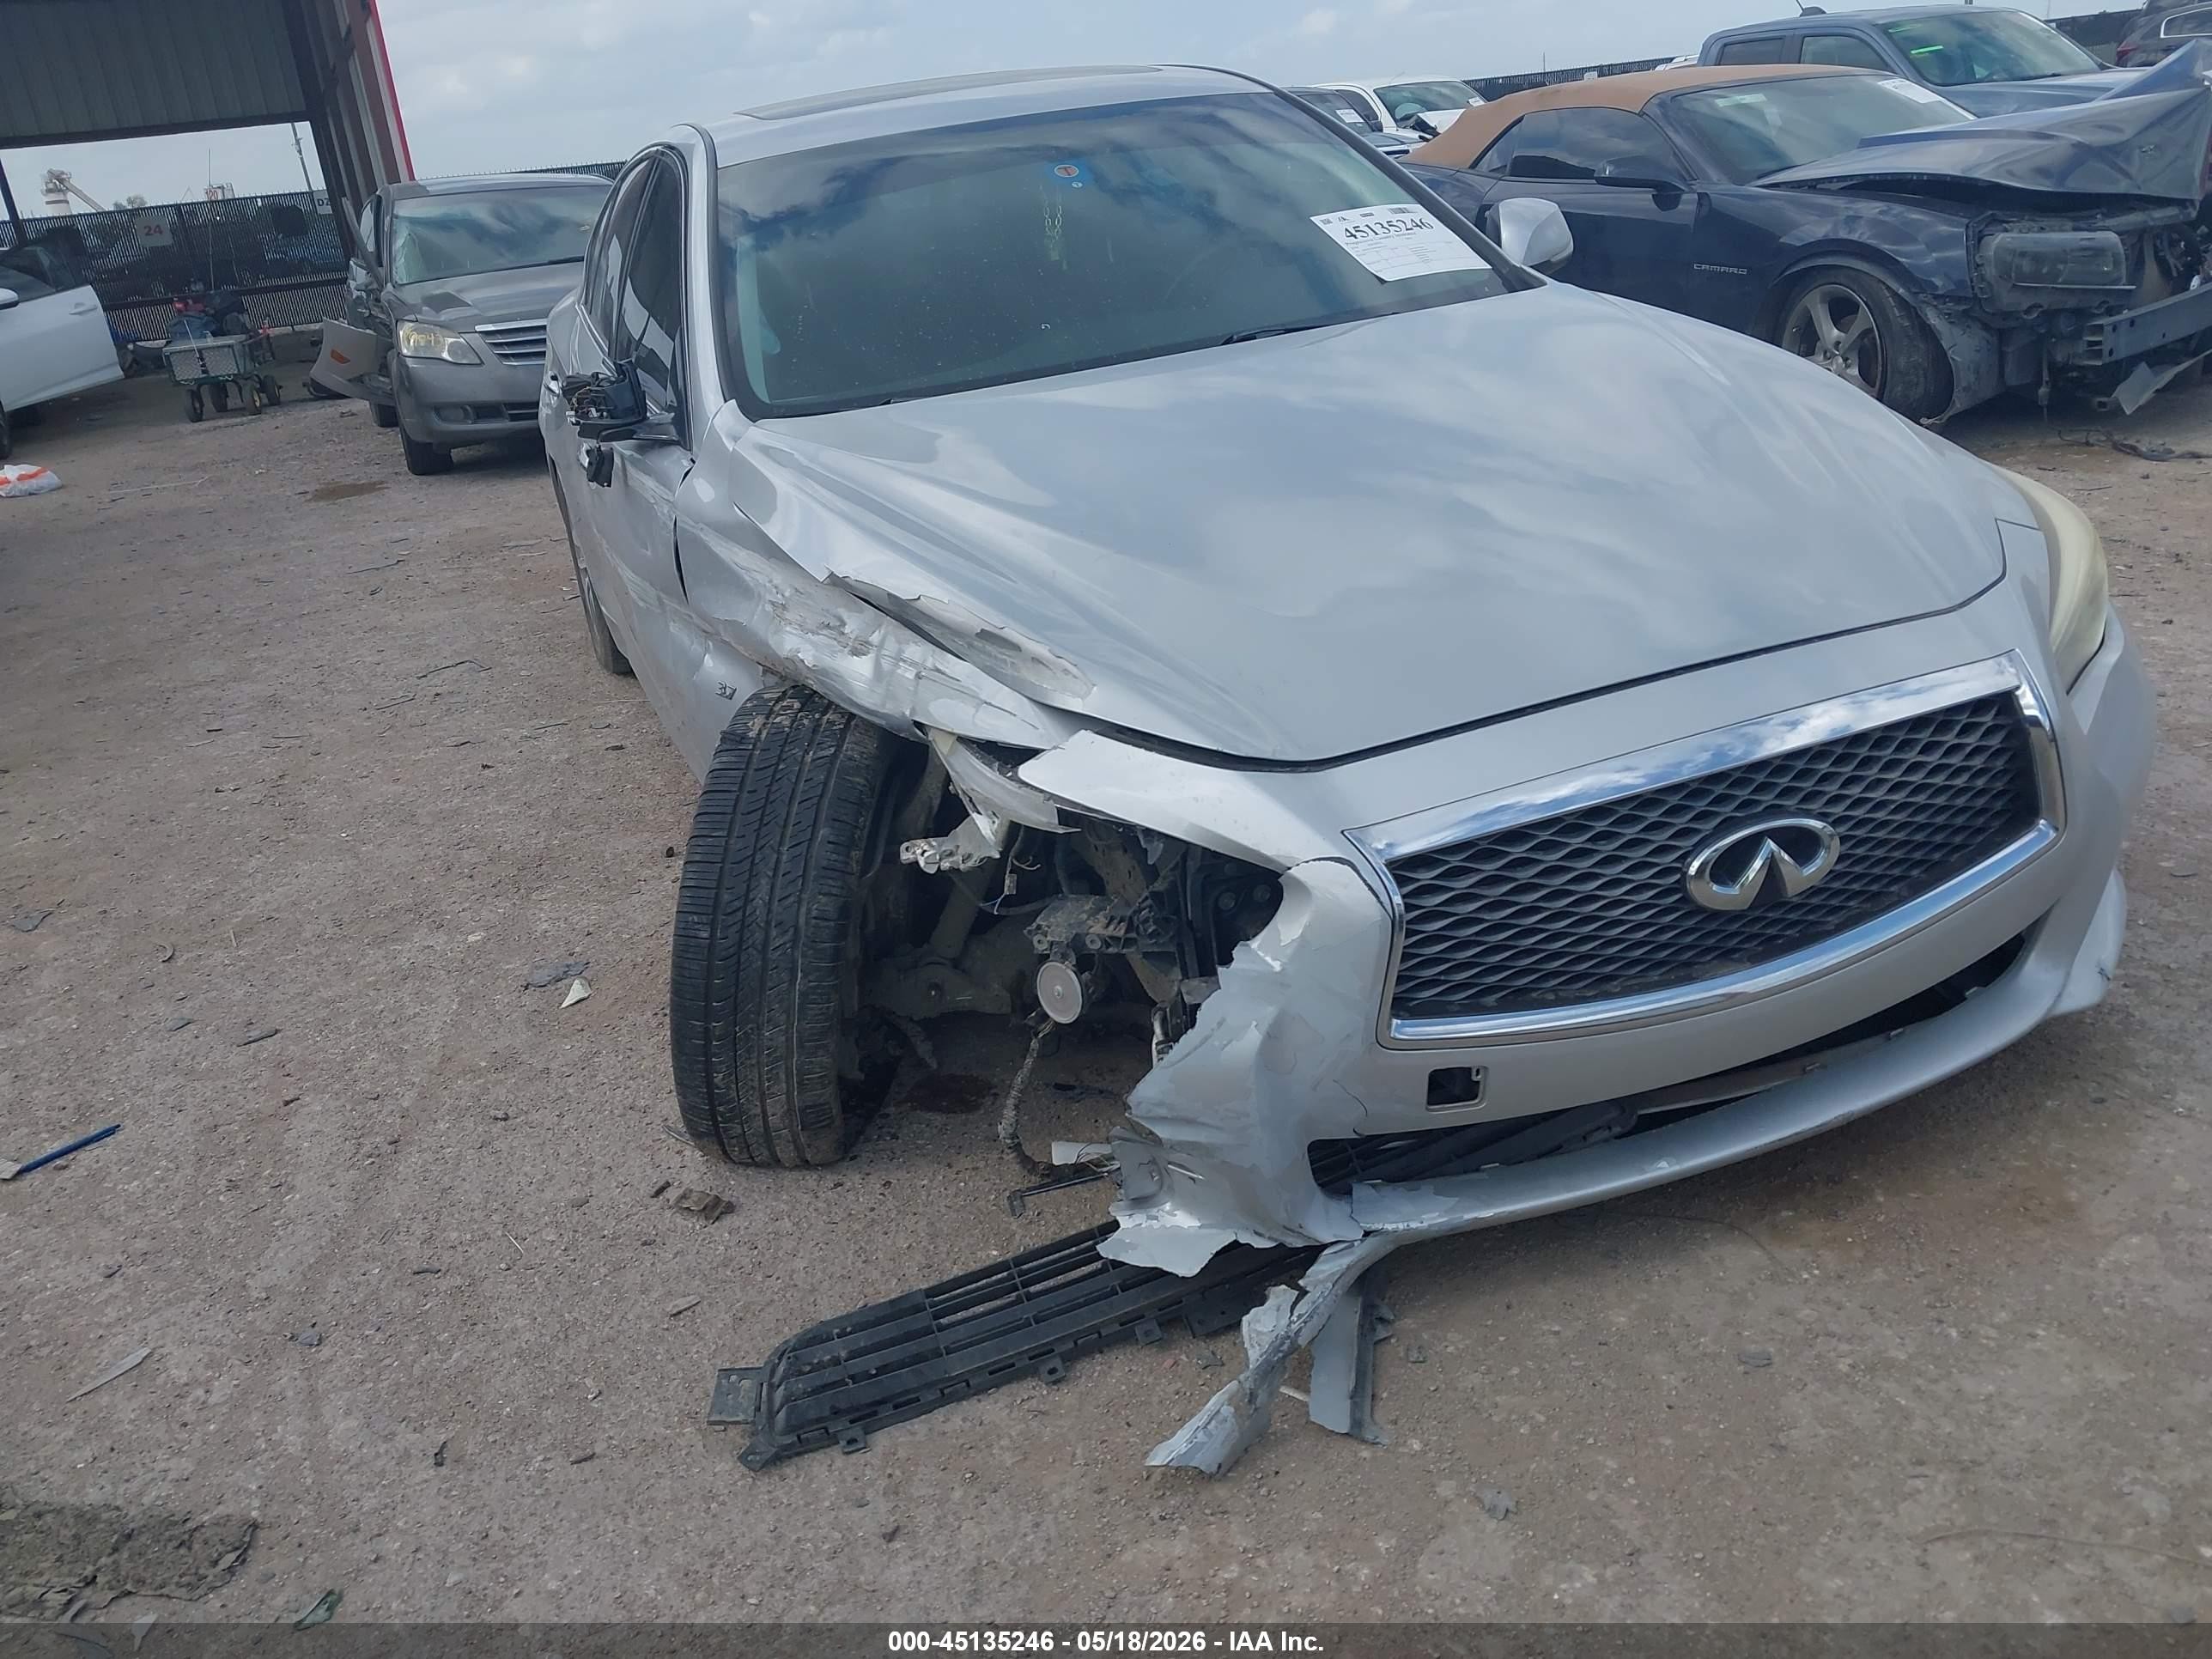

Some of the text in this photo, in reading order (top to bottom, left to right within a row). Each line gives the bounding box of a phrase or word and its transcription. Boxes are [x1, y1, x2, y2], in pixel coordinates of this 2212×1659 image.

[143, 224, 163, 236] 24
[1344, 218, 1434, 240] 45135246
[1693, 263, 1747, 275] CAMARO
